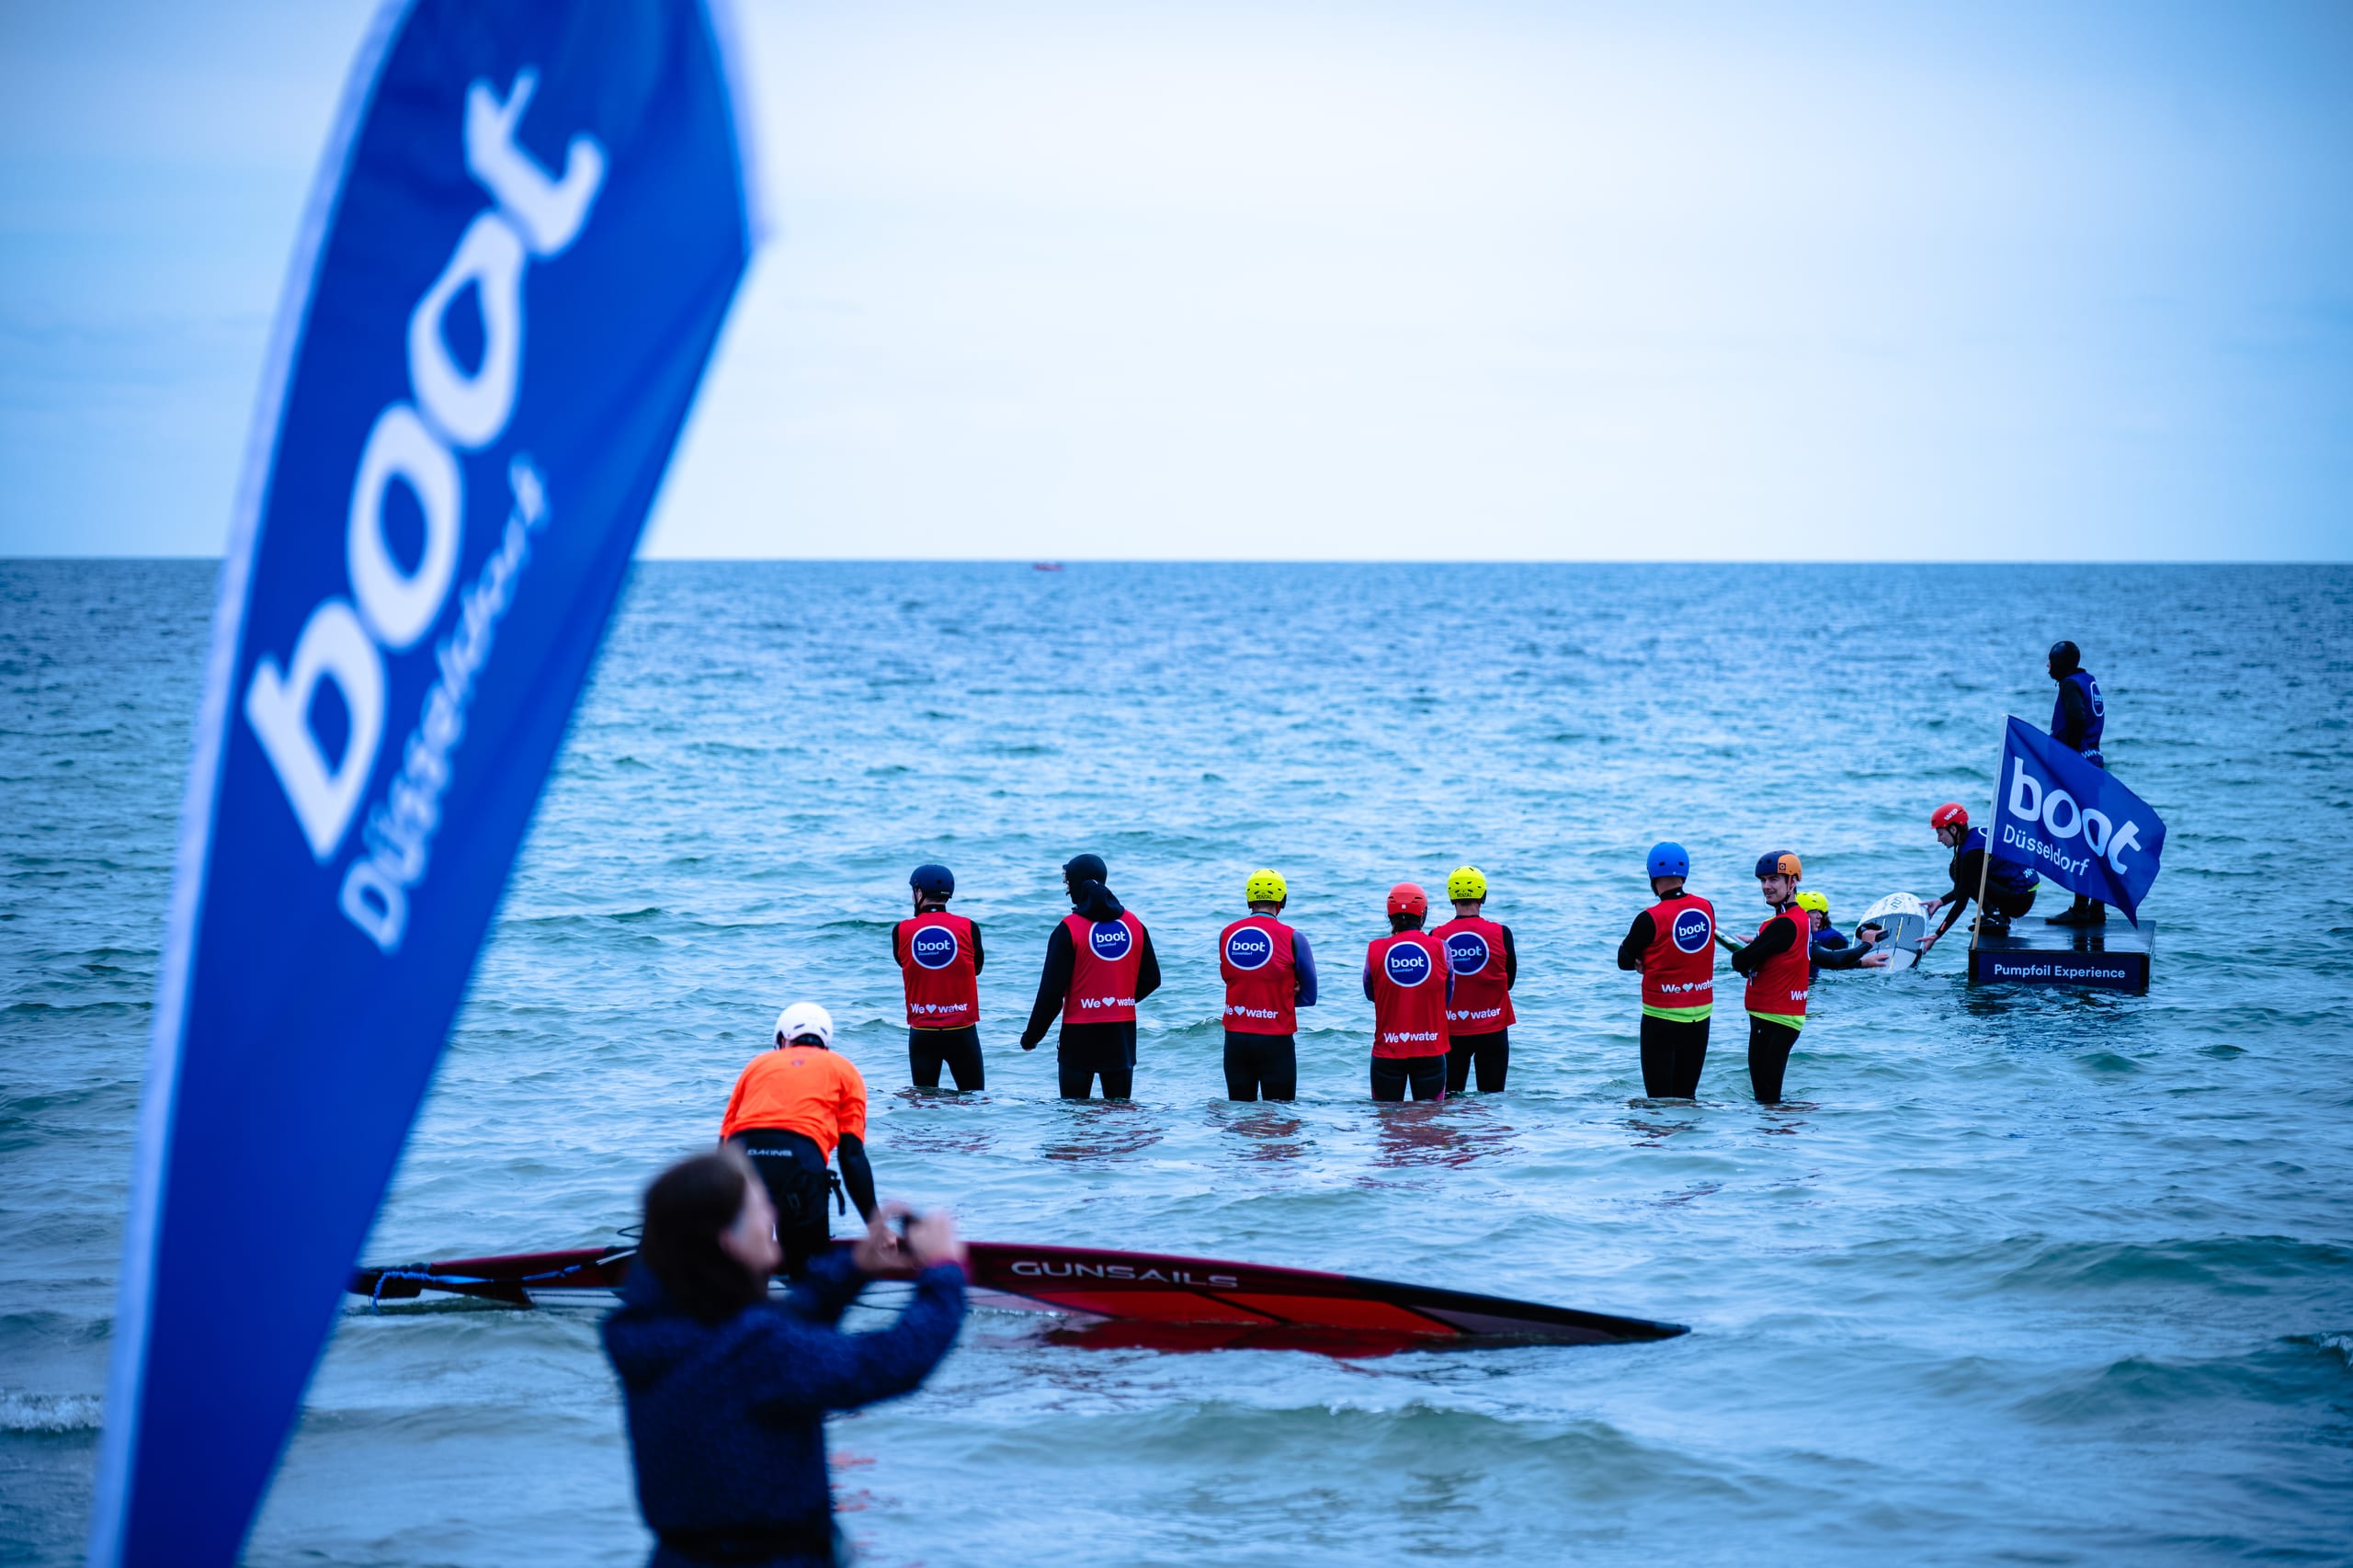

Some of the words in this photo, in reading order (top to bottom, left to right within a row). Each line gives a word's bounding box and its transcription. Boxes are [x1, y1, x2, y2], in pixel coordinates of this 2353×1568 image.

[248, 69, 605, 862] boot
[2008, 756, 2142, 875] boot
[2003, 824, 2090, 876] Düsseldorf
[1678, 922, 1707, 937] boot
[1096, 931, 1127, 944] boot
[917, 939, 951, 951] boot
[1232, 940, 1266, 952] boot
[1391, 956, 1425, 968] boot
[1994, 963, 2051, 978] Pumpfoil
[2054, 965, 2126, 979] Experience
[1661, 983, 1681, 994] We
[1790, 990, 1803, 1001] We
[910, 1003, 926, 1014] We
[938, 1003, 968, 1014] water
[1081, 998, 1101, 1009] We
[1117, 996, 1136, 1006] wate
[1245, 1008, 1279, 1019] water
[1471, 1007, 1501, 1019] water
[1383, 1032, 1399, 1043] We
[1410, 1031, 1438, 1042] water
[1010, 1260, 1239, 1288] GUNSAILS
